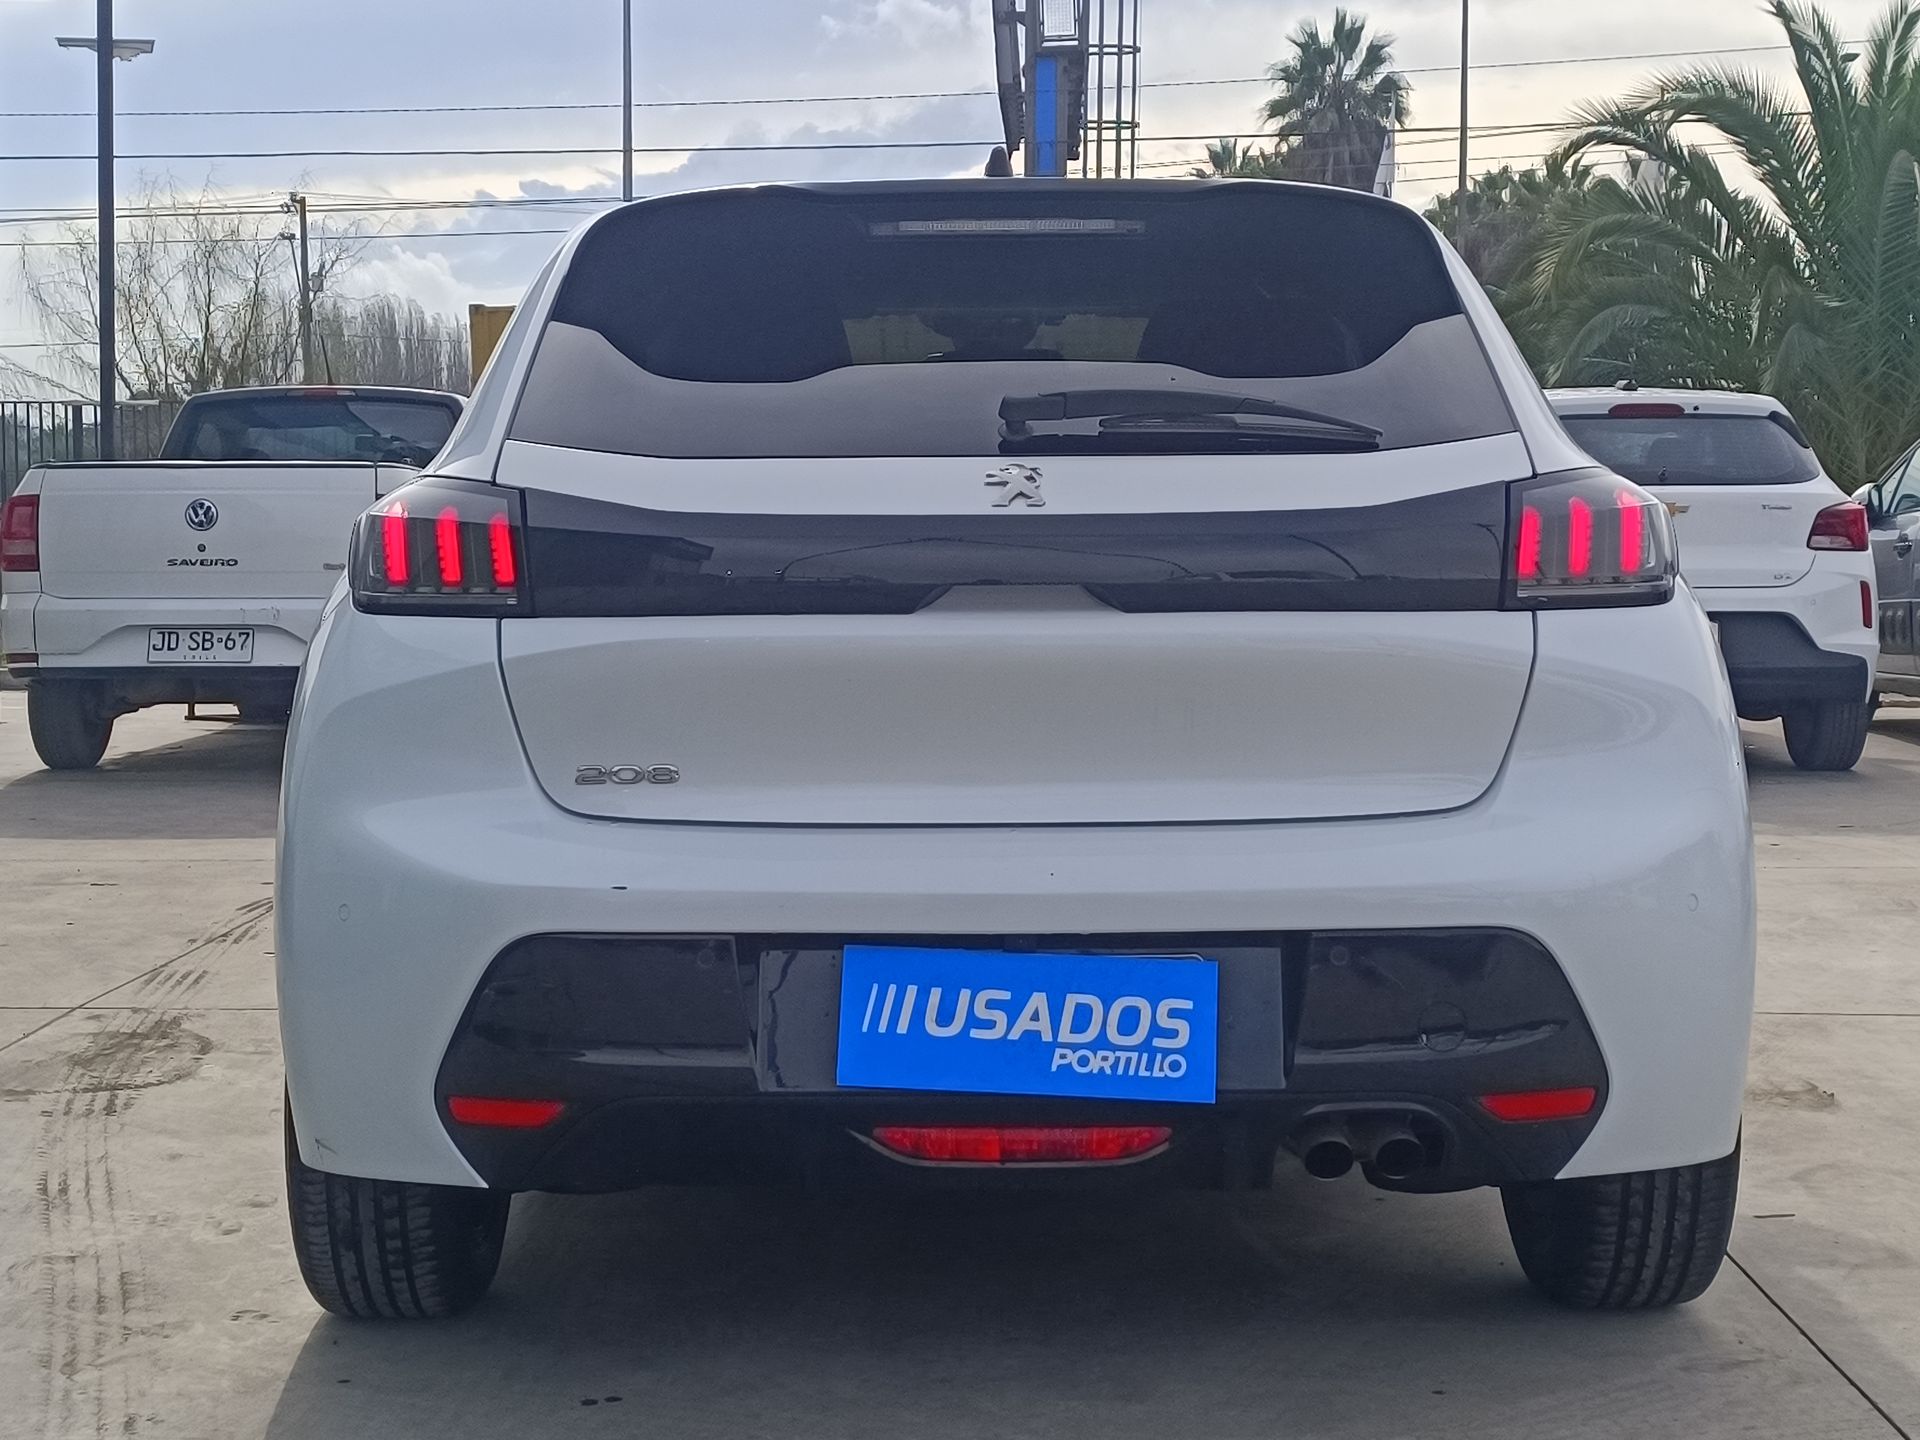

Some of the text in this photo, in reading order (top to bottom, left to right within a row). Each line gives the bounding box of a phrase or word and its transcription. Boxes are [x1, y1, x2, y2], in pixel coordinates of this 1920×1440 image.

[167, 558, 239, 567] SAVEIRO
[574, 763, 680, 785] 208
[924, 986, 1194, 1049] USADOS
[1050, 1047, 1188, 1079] PORTILLO
